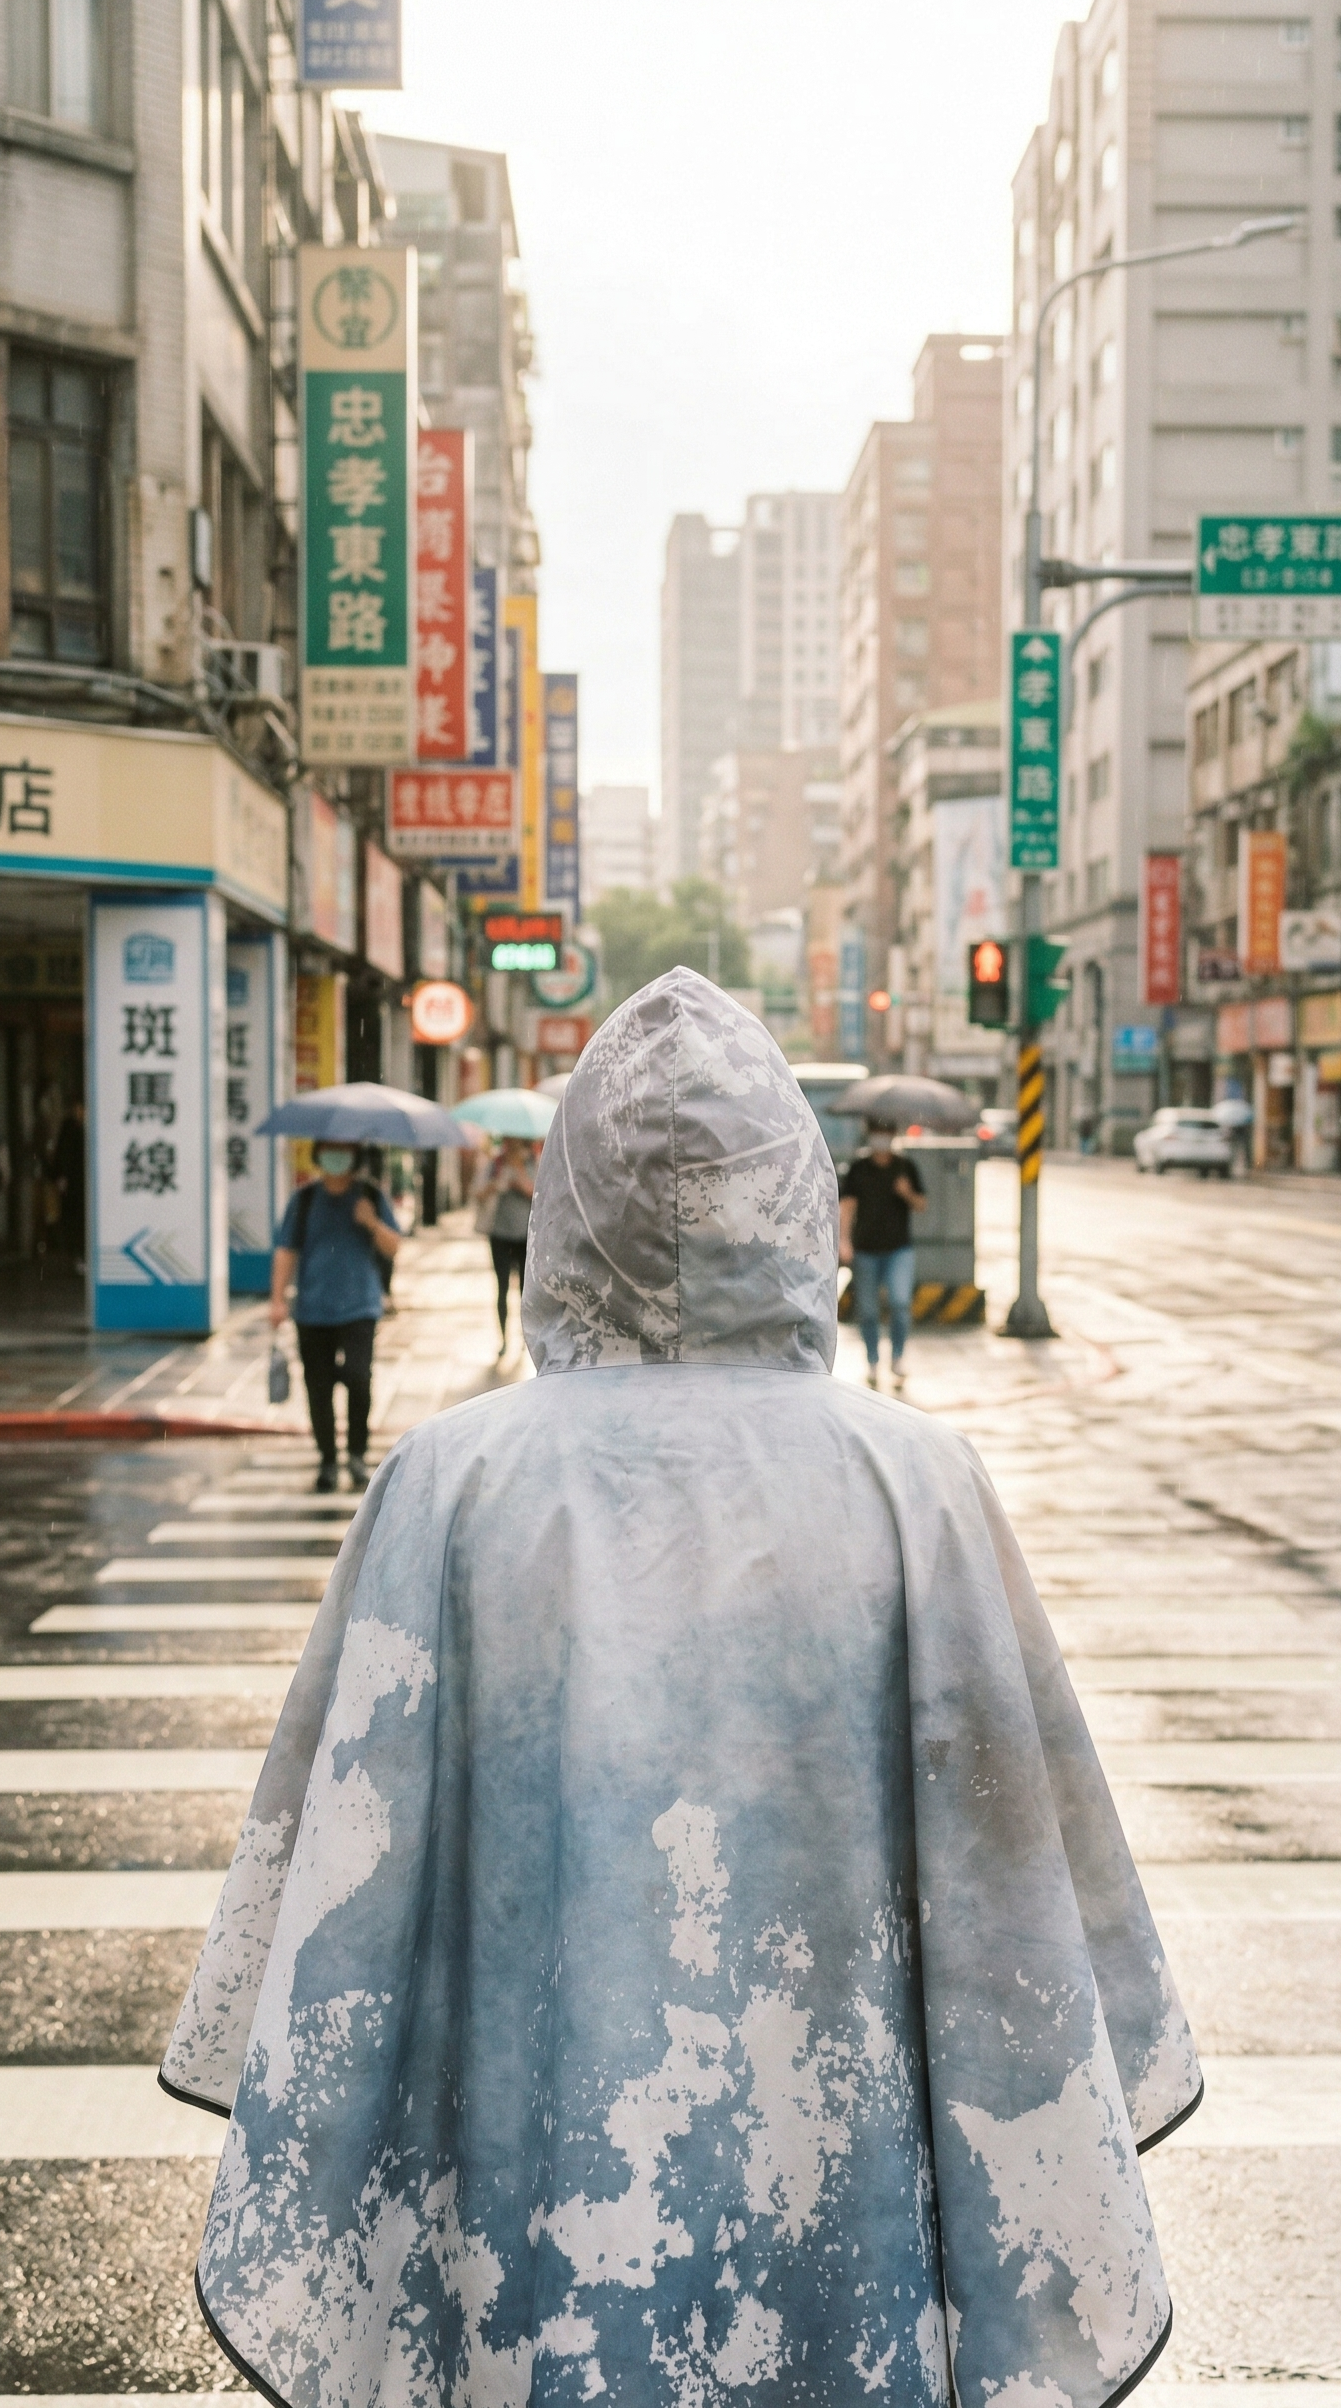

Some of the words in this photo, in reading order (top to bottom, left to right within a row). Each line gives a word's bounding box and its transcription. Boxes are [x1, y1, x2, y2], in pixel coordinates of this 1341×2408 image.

[327, 385, 387, 652] 忠孝東路
[0, 757, 53, 836] 店
[123, 1003, 177, 1195] 斑馬線
